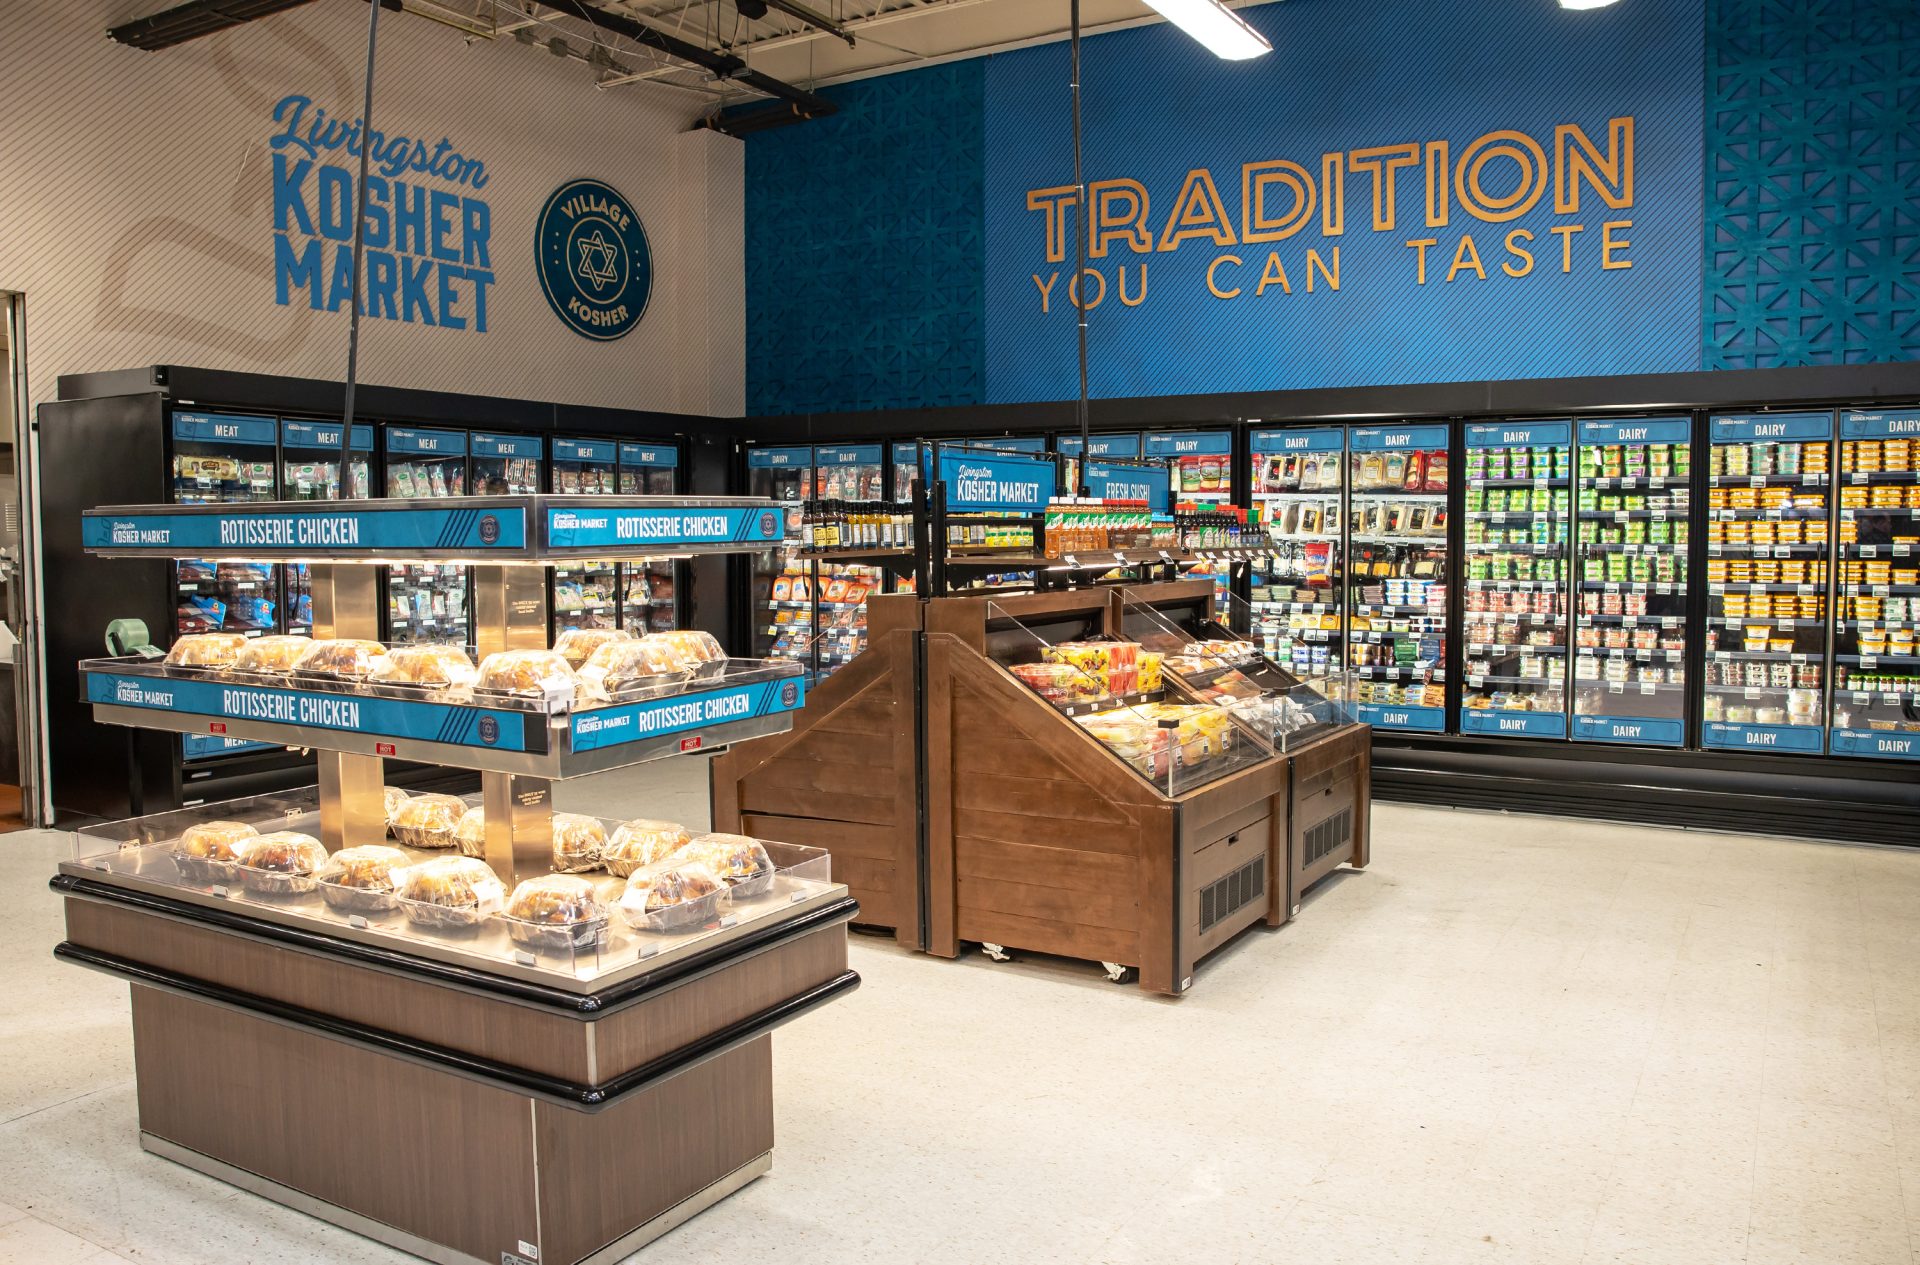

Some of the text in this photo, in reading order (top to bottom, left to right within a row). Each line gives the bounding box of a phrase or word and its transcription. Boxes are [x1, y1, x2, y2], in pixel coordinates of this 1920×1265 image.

[269, 95, 489, 189] Livingston
[1027, 116, 1634, 262] TRADITION
[272, 154, 491, 268] KOSHER
[561, 194, 632, 232] VILLAGE
[1032, 220, 1633, 313] YOU CAN TASTE
[273, 233, 495, 333] MARKET
[568, 296, 629, 327] KOSHER
[215, 425, 239, 437] MEAT
[1618, 428, 1648, 440] DAIRY
[1755, 424, 1786, 436] DAIRY
[318, 433, 339, 444] MEAT
[1285, 438, 1309, 449] DAIRY
[1385, 435, 1410, 446] DAIRY
[1504, 432, 1530, 443] DAIRY
[419, 439, 438, 450] MEAT
[498, 444, 515, 454] MEAT
[1088, 444, 1108, 454] DAIRY
[1176, 441, 1198, 451] DAIRY
[578, 448, 593, 458] MEAT
[642, 452, 655, 461] MEAT
[839, 453, 857, 462] DAIRY
[772, 455, 788, 464] DAIRY
[958, 464, 992, 480] Livingston
[957, 480, 1039, 503] KOSHER MARKET
[1106, 482, 1150, 501] FRESH SUSHI
[554, 518, 608, 528] KOSHER MARKET
[616, 516, 728, 538] ROTISSERIE CHICKEN
[112, 530, 170, 544] KOSHER MARKET
[220, 518, 358, 544] ROTISSERIE CHICKEN
[117, 687, 174, 706] KOSHER MARKET
[224, 689, 360, 729] ROTISSERIE CHICKEN
[639, 694, 749, 734] ROTISSERIE CHICKEN
[1384, 713, 1408, 724] DAIRY
[1500, 719, 1526, 730] DAIRY
[576, 716, 630, 734] KOSHER MARKET
[1613, 725, 1642, 737] DAIRY
[1746, 732, 1776, 745] DAIRY
[1878, 740, 1911, 752] DAIRY
